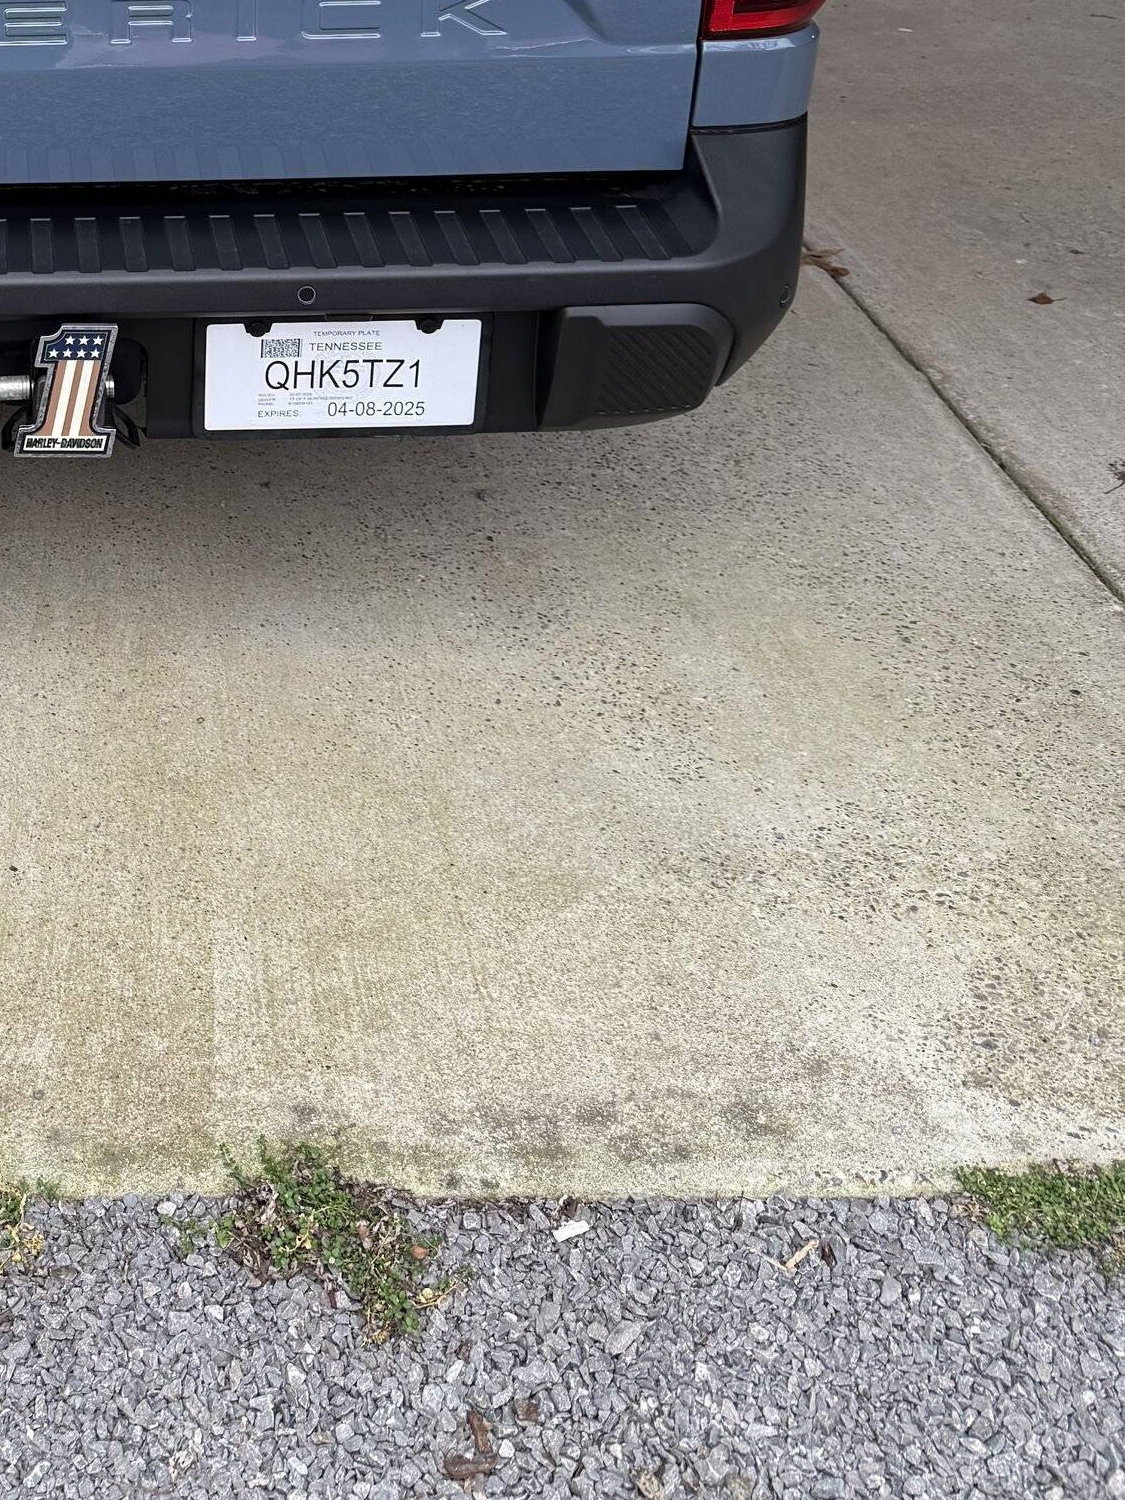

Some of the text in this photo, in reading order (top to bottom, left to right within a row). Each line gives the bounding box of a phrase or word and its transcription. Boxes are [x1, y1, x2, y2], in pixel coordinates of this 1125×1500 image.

[309, 342, 383, 351] TENNESSEE
[265, 359, 421, 391] QHK5TZ1
[328, 401, 425, 417] 04-08-2025
[26, 438, 103, 449] HARLEY-DAVIDSON
